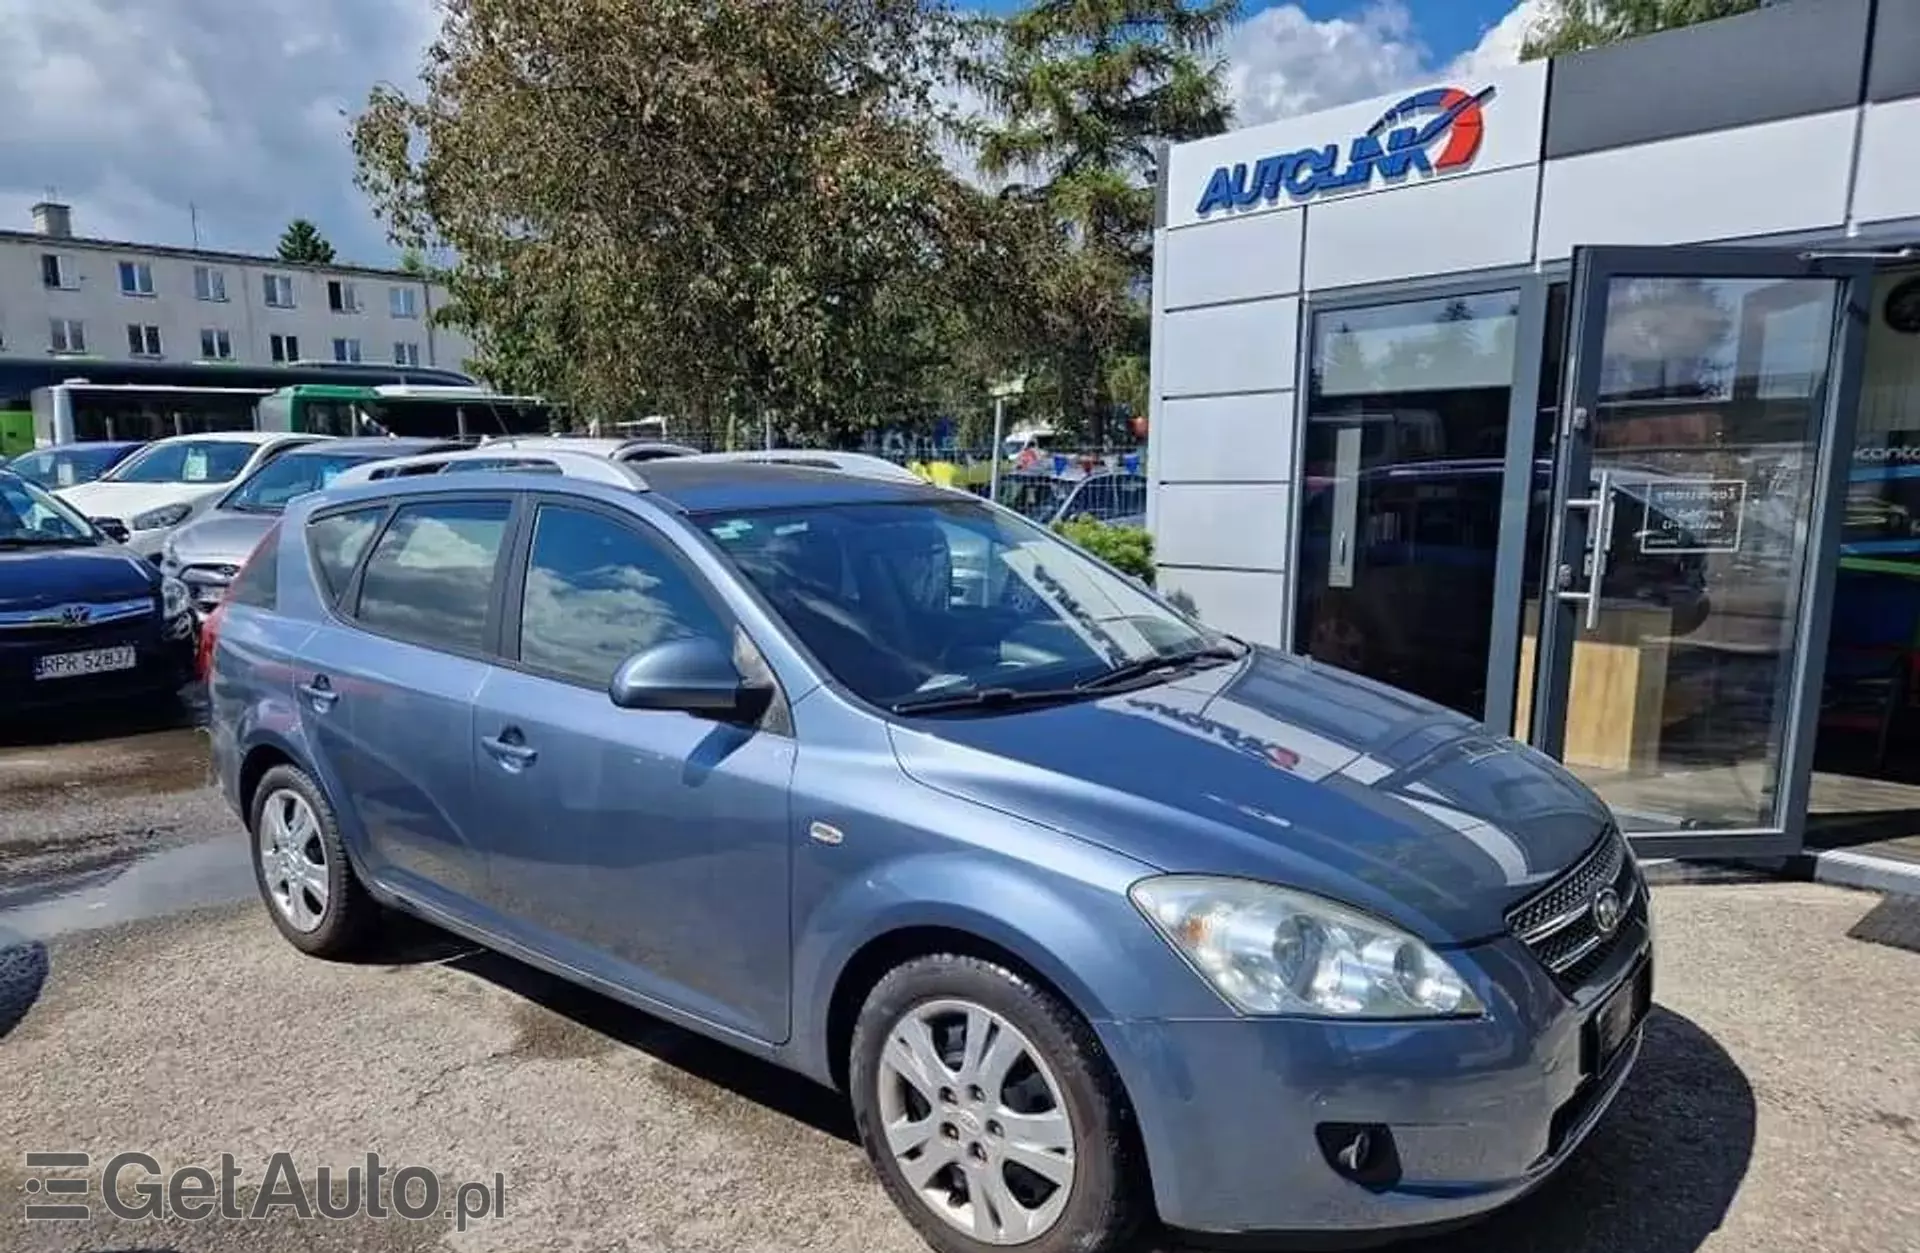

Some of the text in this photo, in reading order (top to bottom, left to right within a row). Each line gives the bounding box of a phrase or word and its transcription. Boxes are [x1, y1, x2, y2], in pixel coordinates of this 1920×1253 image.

[1197, 120, 1438, 214] AUTOLINK
[42, 646, 132, 673] RPR 52837
